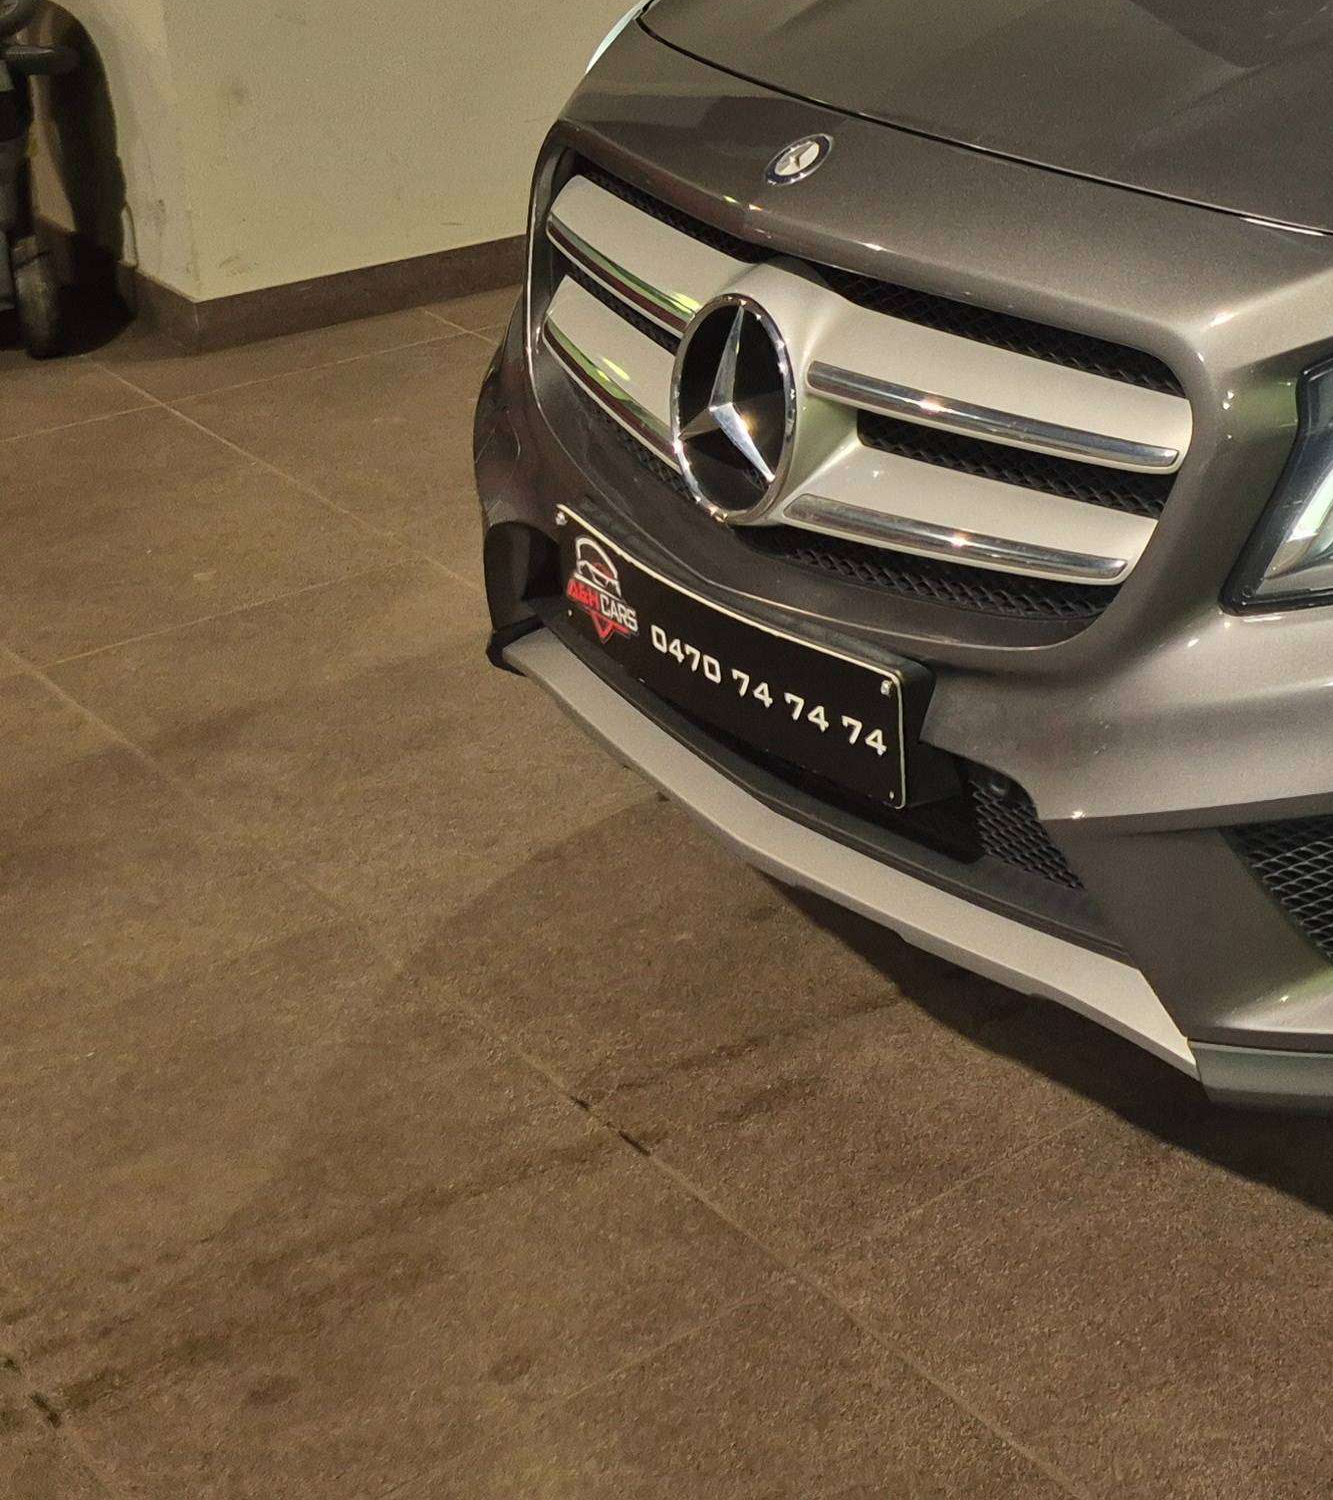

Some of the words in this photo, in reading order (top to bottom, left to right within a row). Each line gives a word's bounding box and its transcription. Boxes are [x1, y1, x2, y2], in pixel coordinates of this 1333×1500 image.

[600, 593, 639, 633] CARS
[651, 624, 722, 684] 0470
[731, 668, 774, 708] 74
[784, 692, 830, 733] 74
[841, 715, 888, 756] 74
